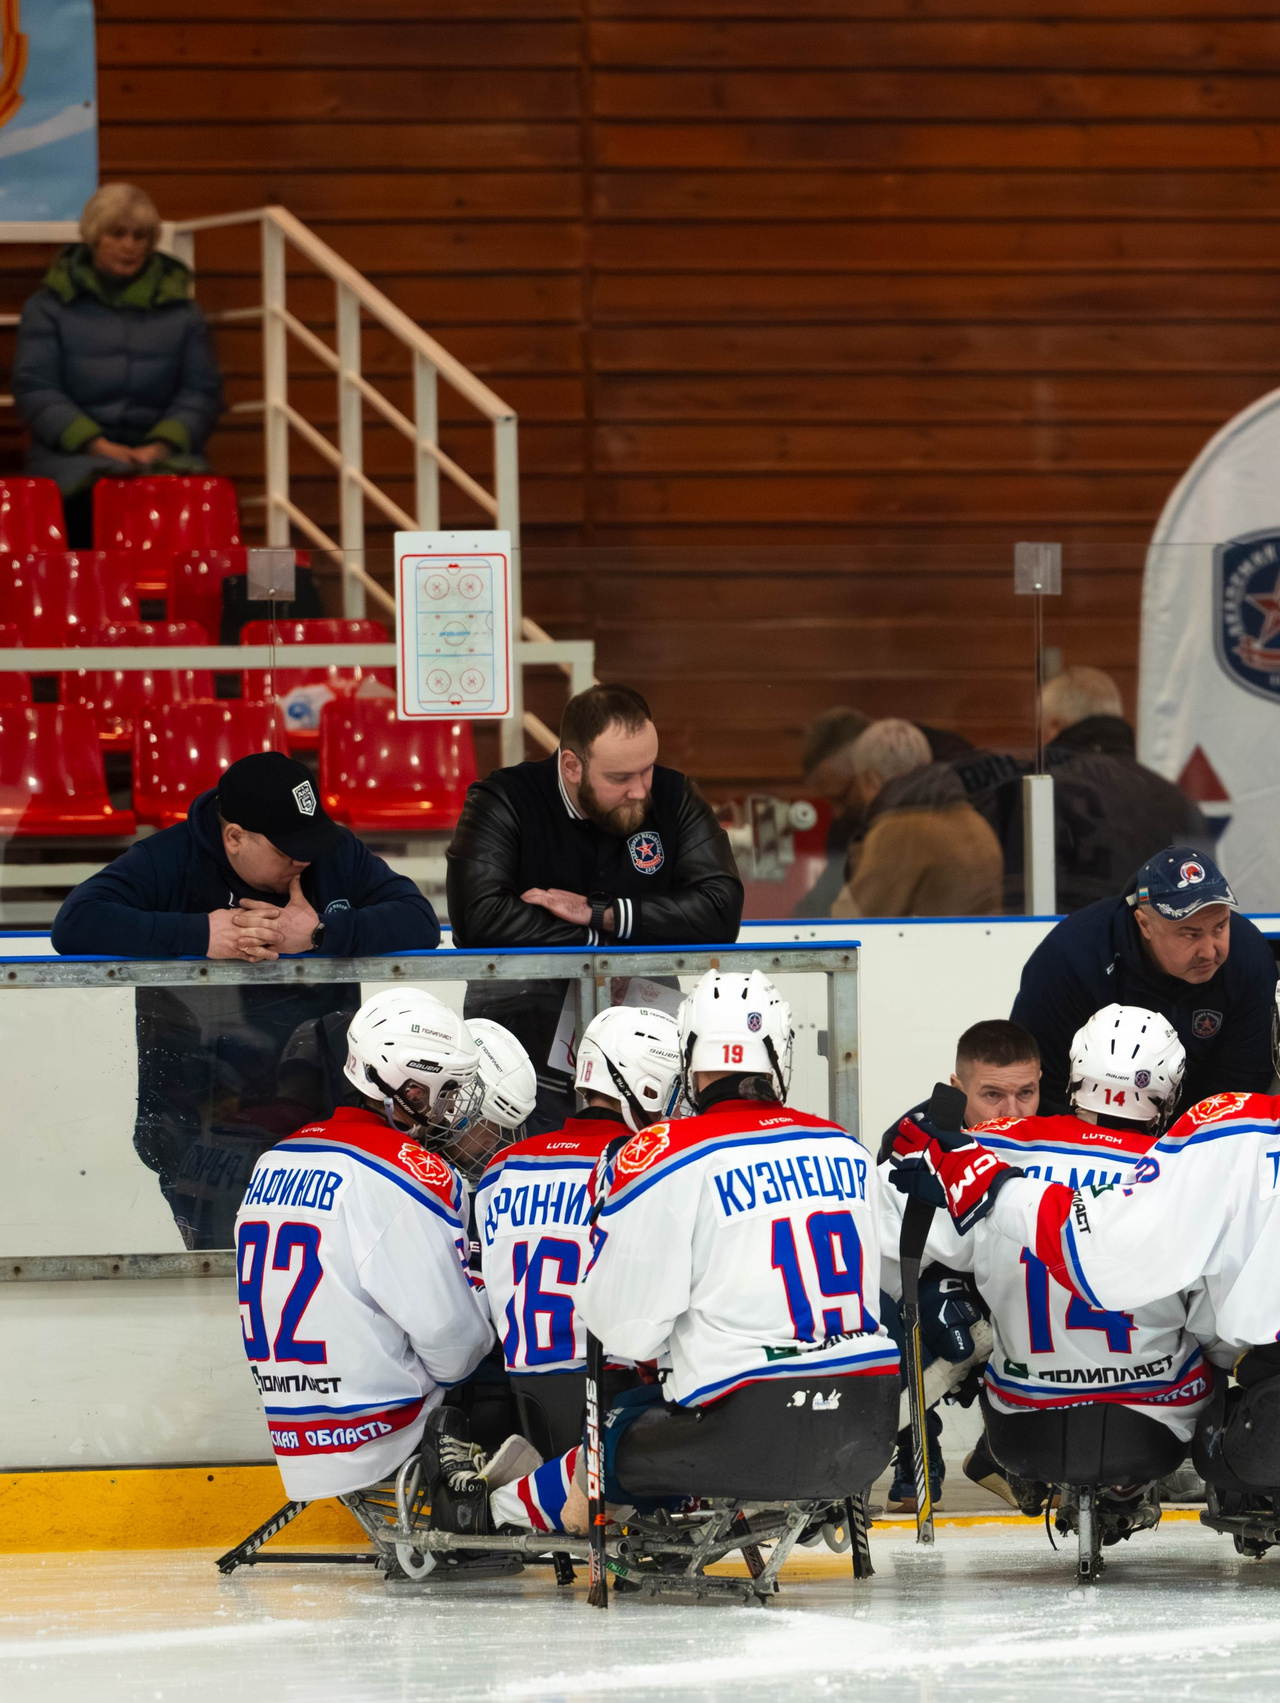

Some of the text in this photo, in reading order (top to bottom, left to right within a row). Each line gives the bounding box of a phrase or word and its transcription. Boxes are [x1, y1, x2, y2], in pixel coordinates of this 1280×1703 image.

[722, 1044, 744, 1064] 19
[1104, 1088, 1126, 1106] 14
[546, 1142, 580, 1150] LUTCH
[1082, 1132, 1123, 1144] LUTCH
[714, 1155, 867, 1217] КУЗНЕЦОВ
[771, 1210, 880, 1344] 19
[238, 1220, 328, 1365] 92
[503, 1236, 581, 1368] 16
[270, 1420, 393, 1448] СКАЯ ОБЛАСТЬ
